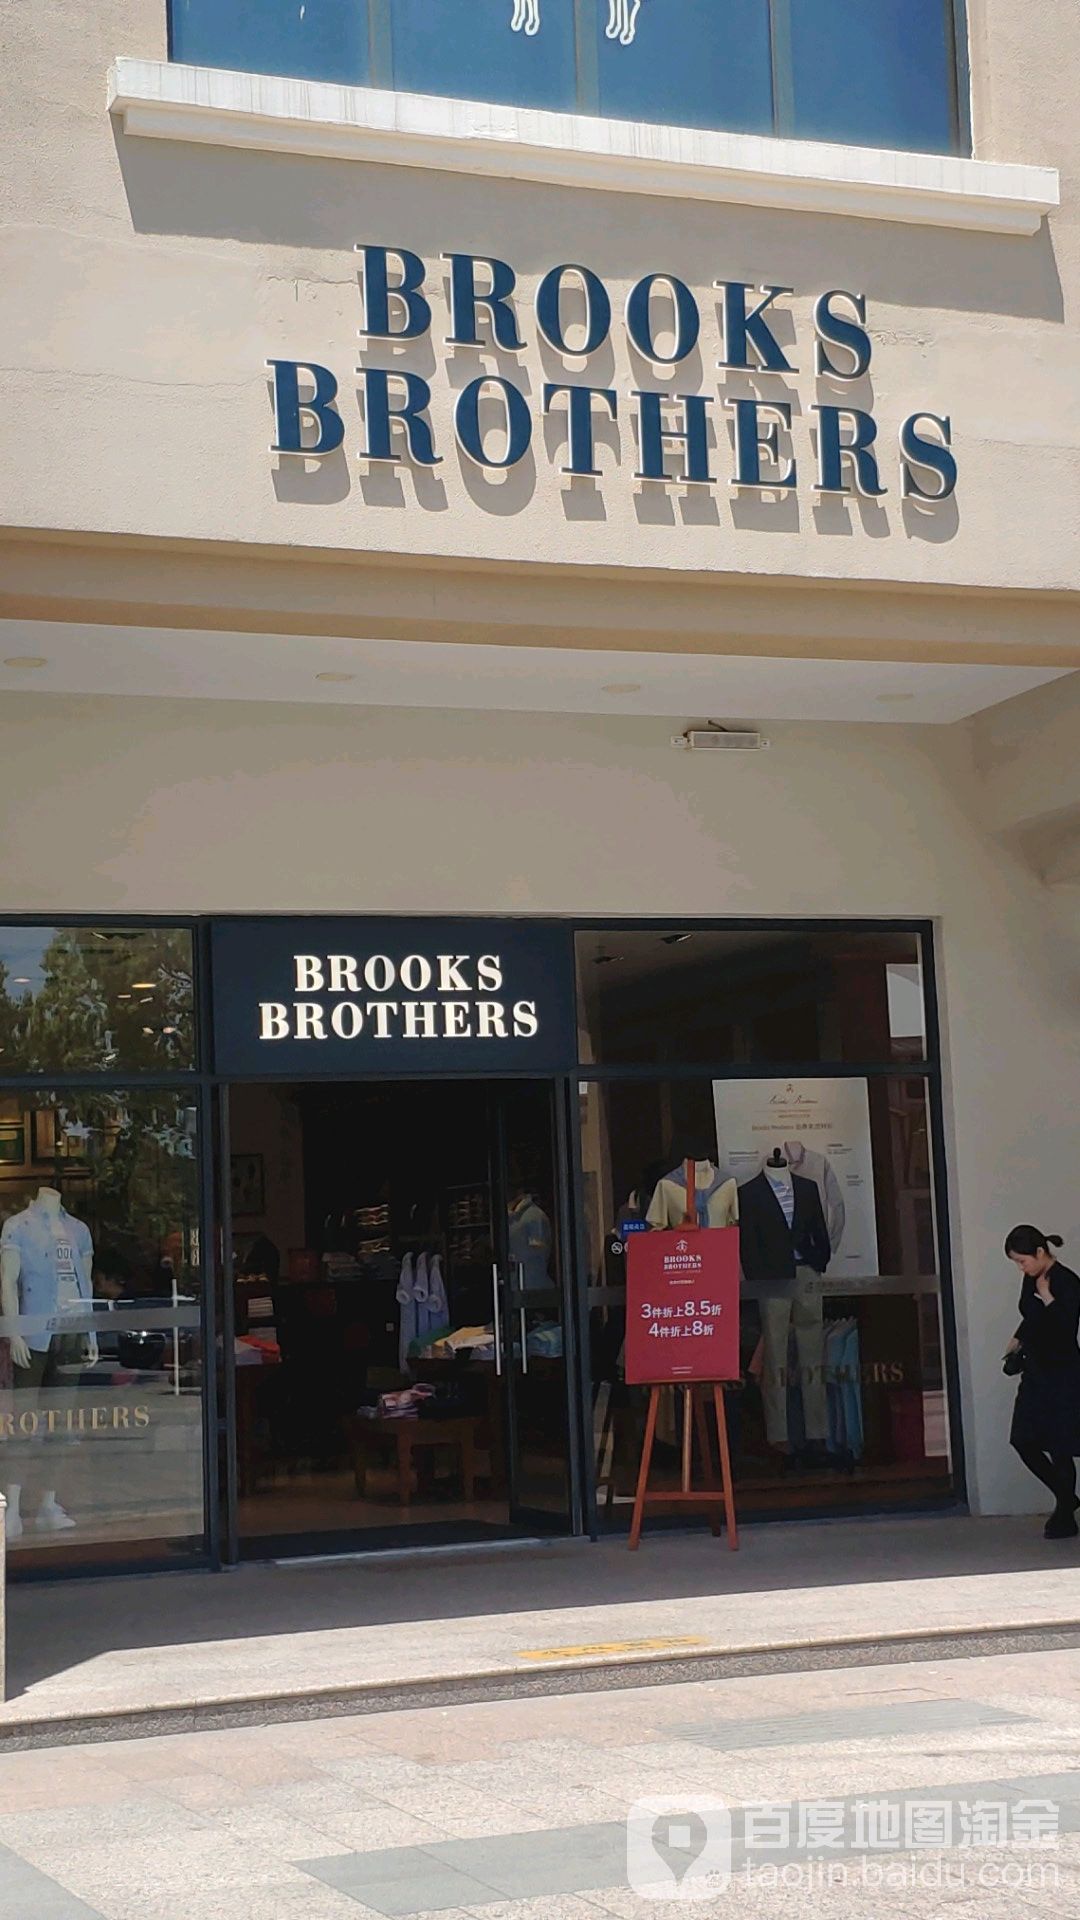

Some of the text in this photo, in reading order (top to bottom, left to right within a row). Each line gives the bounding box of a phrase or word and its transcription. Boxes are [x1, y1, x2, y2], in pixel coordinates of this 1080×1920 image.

[354, 244, 872, 381] BROOKS
[266, 358, 958, 501] BROTHERS
[293, 954, 504, 992] BROOKS
[258, 1000, 539, 1040] BROTHERS
[663, 1254, 702, 1264] BROOKS
[663, 1263, 702, 1271] BROTHERS
[641, 1300, 722, 1319] 3件折上8.5折
[648, 1320, 714, 1338] 4件折上8折
